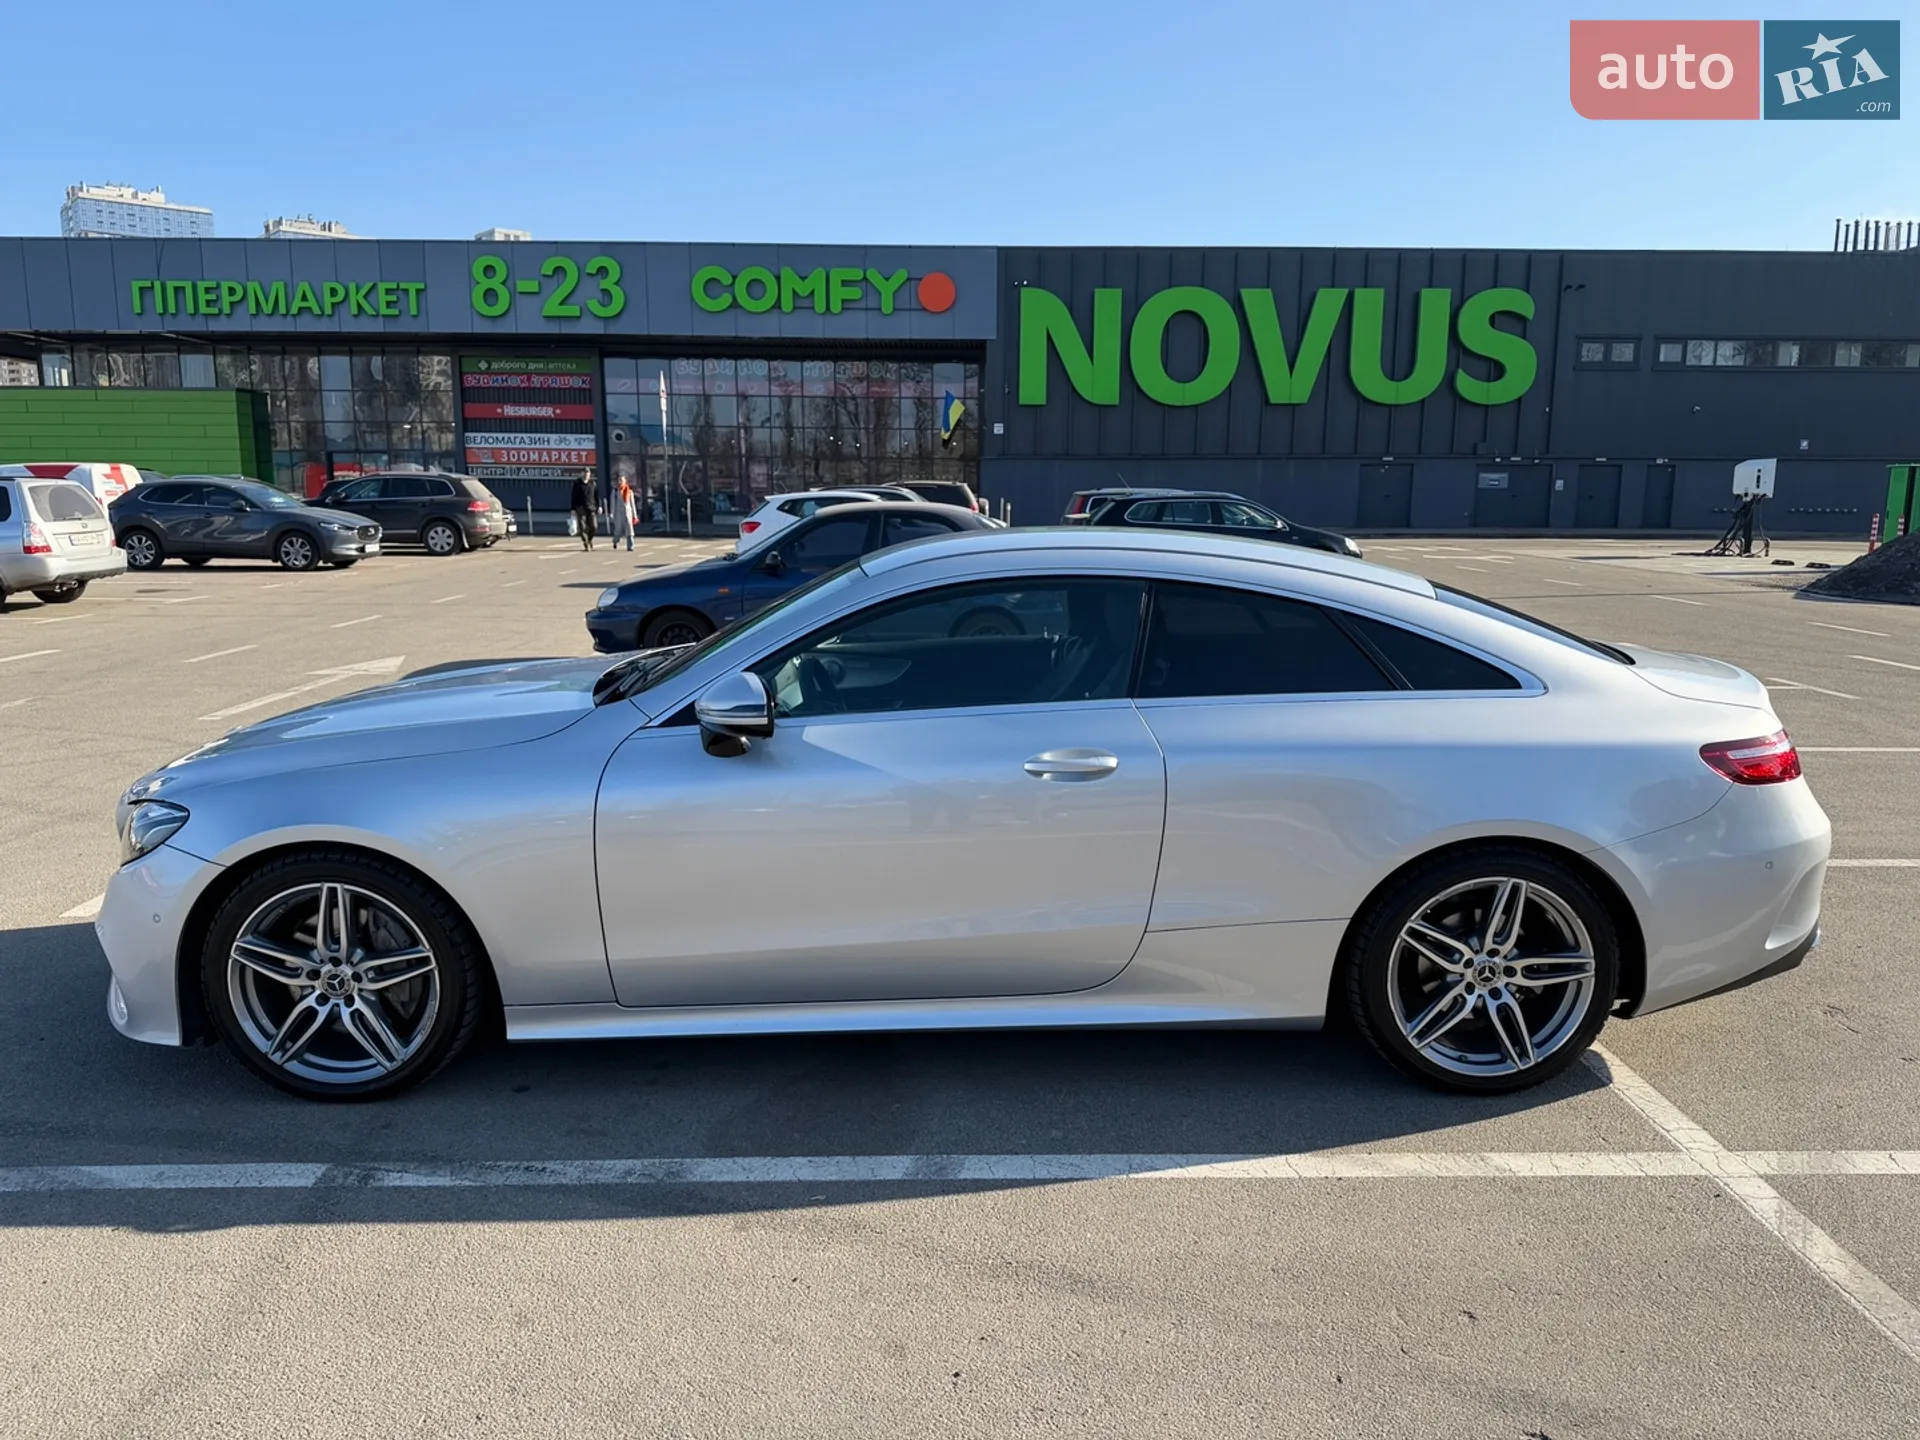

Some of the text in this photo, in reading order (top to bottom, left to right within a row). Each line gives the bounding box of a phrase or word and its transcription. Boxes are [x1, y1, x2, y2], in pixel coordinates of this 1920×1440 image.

[130, 280, 426, 316] ГІПЕРМАРКЕТ
[470, 255, 627, 319] 8-23
[691, 265, 909, 315] COMFY
[1018, 286, 1538, 407] NOVUS
[490, 361, 578, 371] доброго дня аптека
[463, 374, 528, 388] БУДИНОК
[465, 435, 550, 446] ВЕЛОМАГАЗИН
[500, 450, 588, 463] ЗООМАРКЕТ
